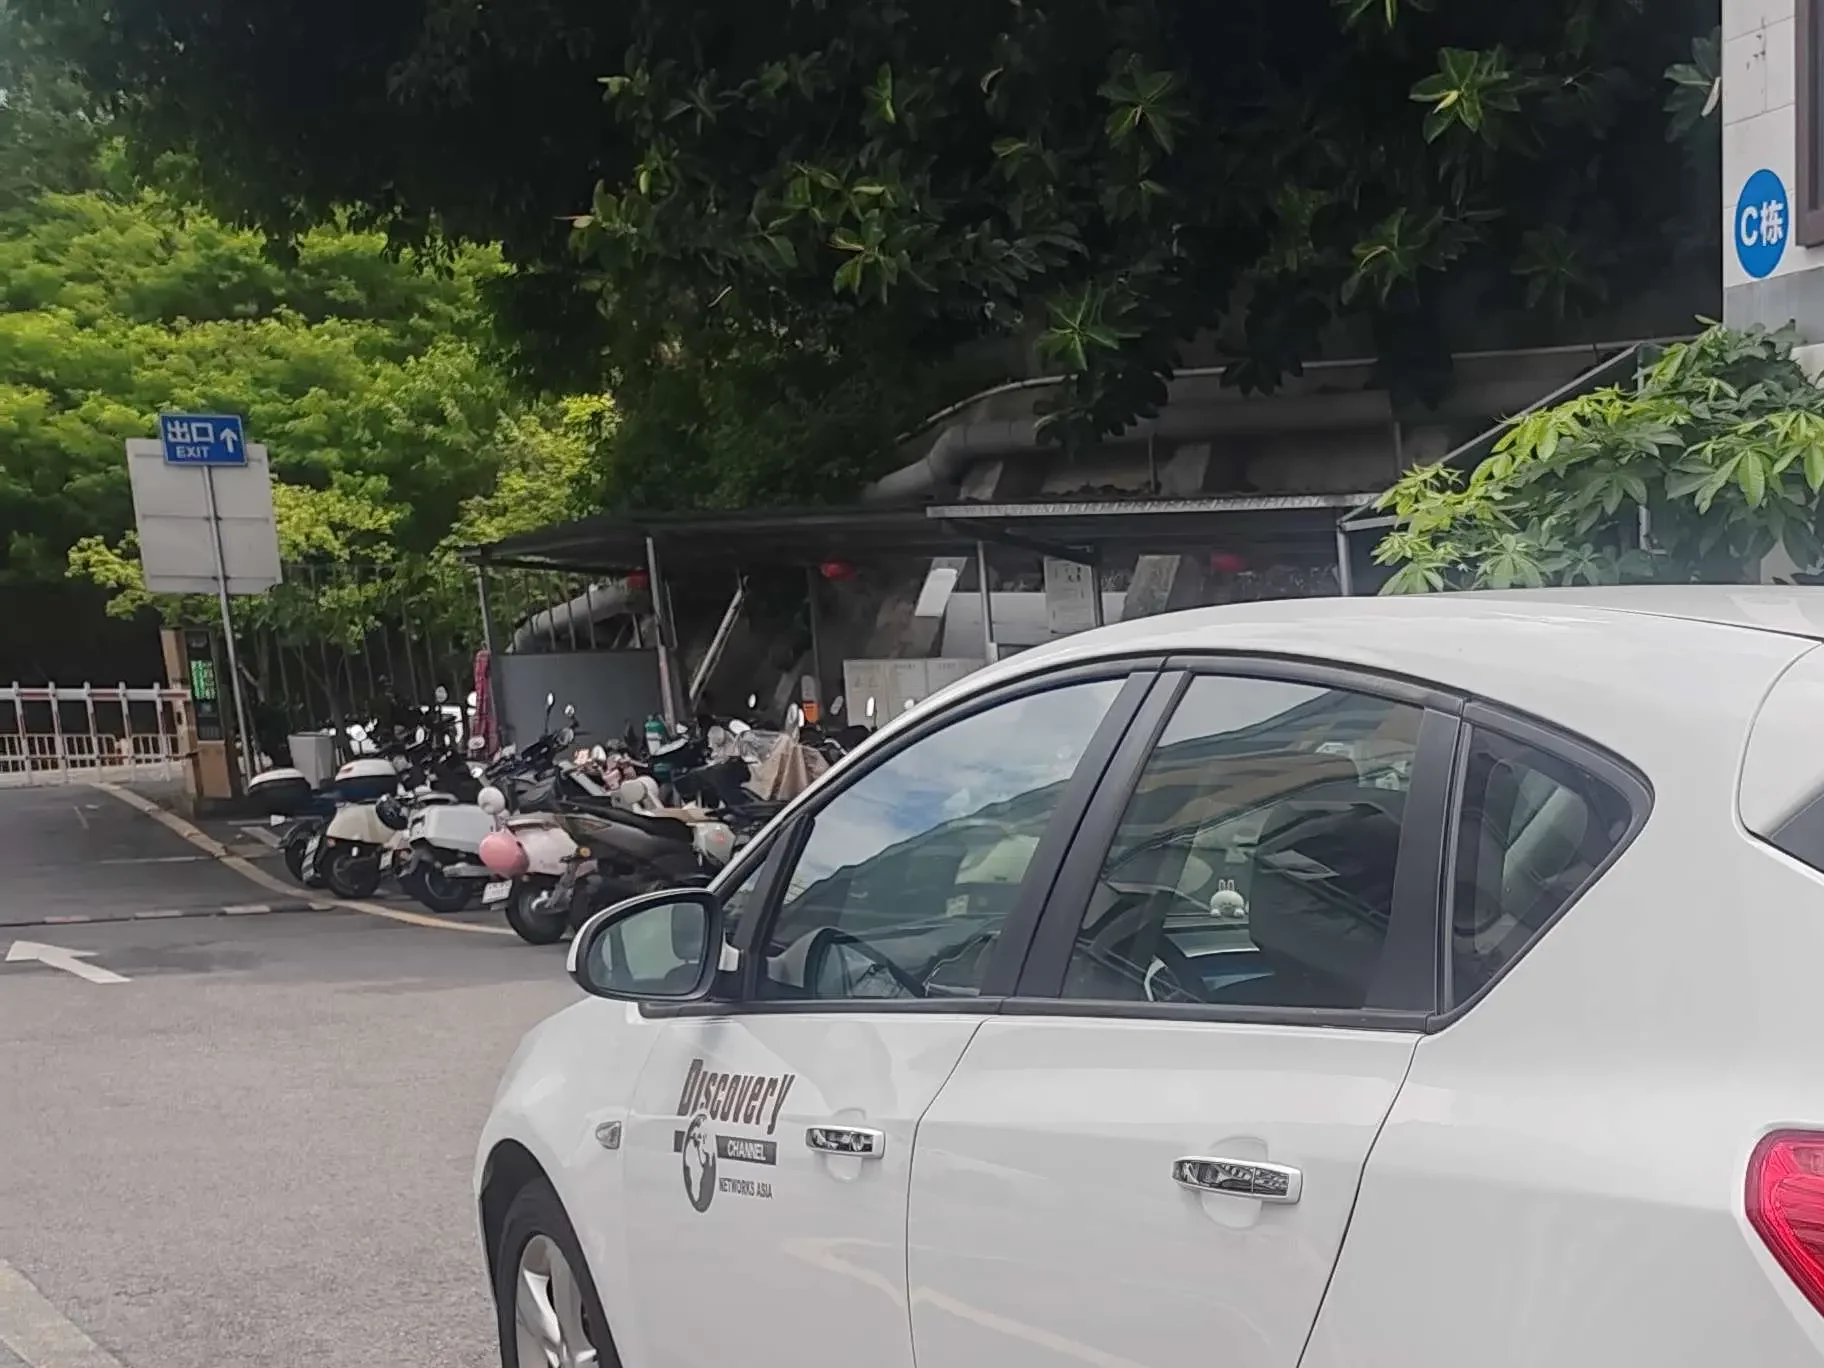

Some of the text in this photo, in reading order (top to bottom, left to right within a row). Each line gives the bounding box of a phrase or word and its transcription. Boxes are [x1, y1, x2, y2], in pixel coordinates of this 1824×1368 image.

[1741, 200, 1784, 247] C栋
[166, 419, 215, 444] 出口
[175, 445, 210, 459] EXIT
[727, 1139, 767, 1161] CHANNEL
[718, 1177, 773, 1200] NETWORKS ASIA
